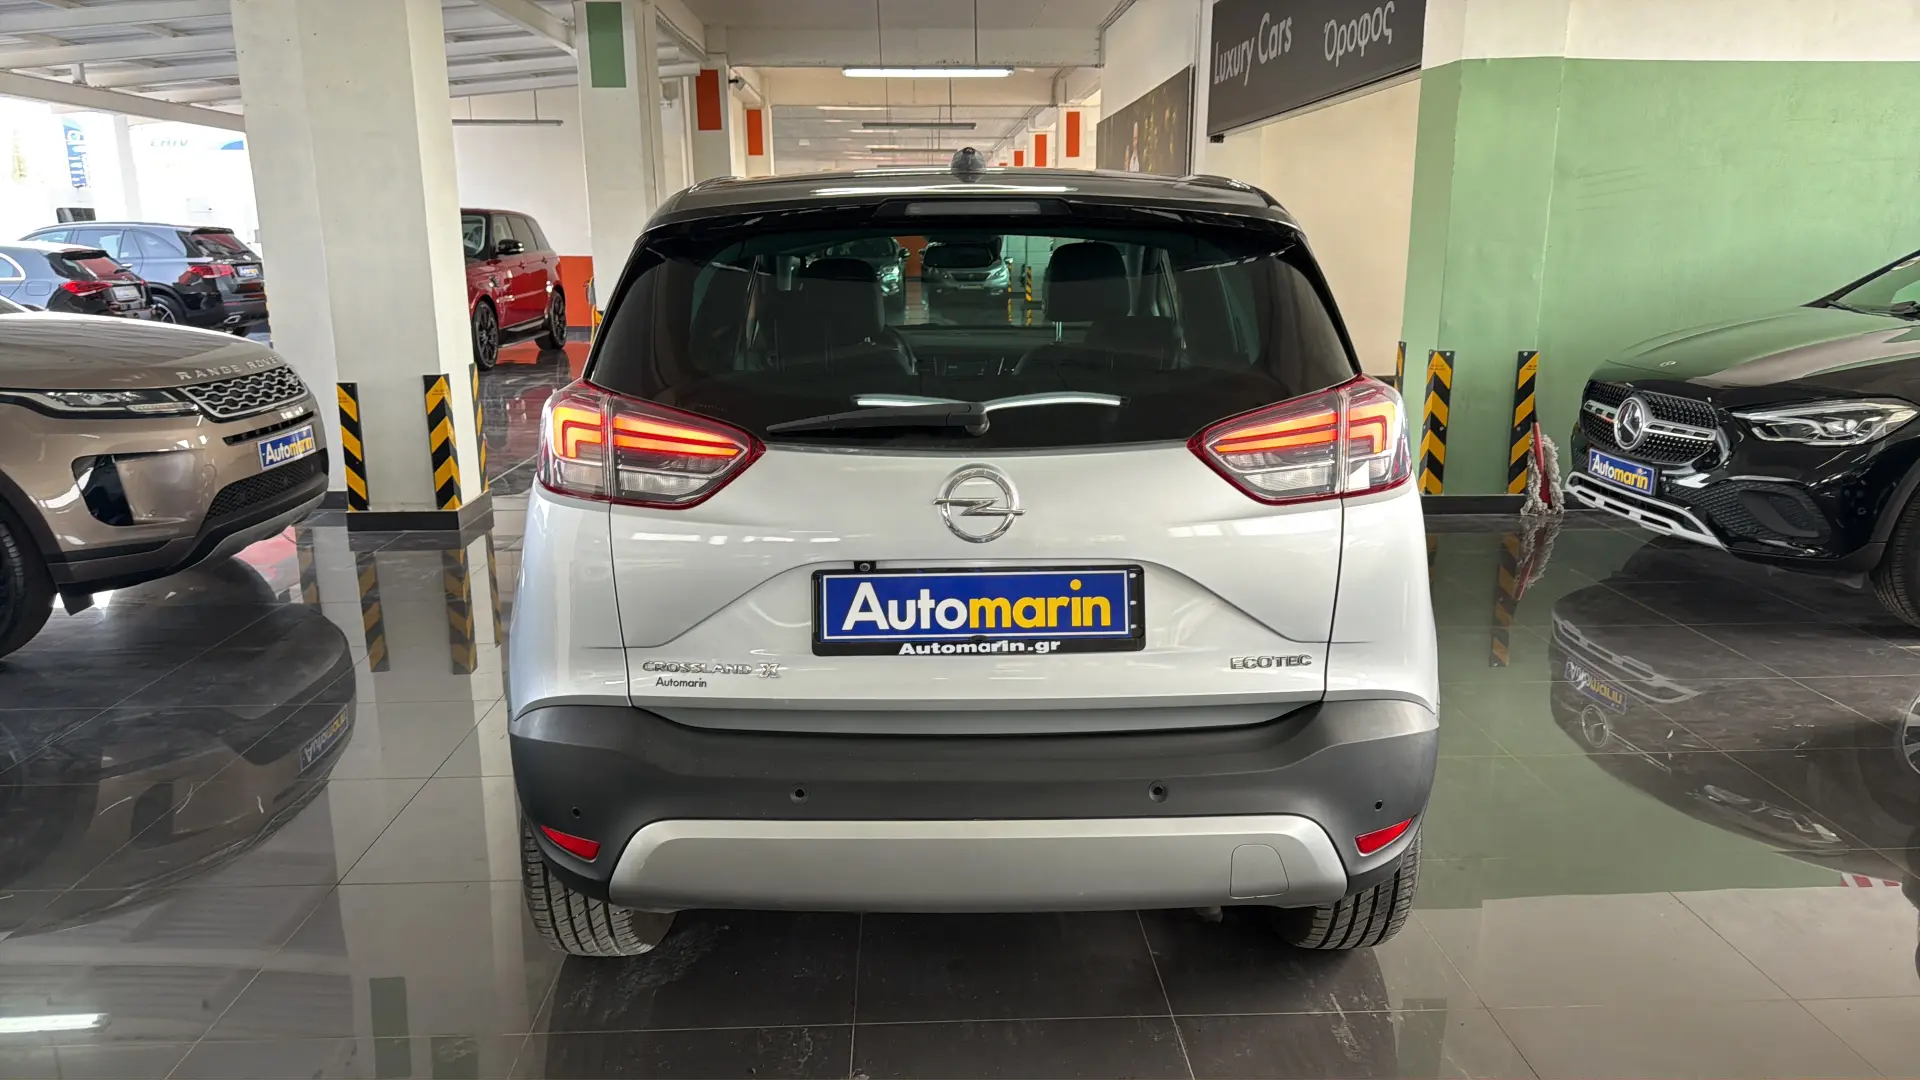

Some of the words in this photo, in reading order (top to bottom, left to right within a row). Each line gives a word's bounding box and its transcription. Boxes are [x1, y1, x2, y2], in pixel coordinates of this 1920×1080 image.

[1324, 0, 1395, 67] Όροφος
[1213, 37, 1255, 86] Luxury
[1258, 12, 1293, 64] Cars
[175, 364, 241, 380] RANGE
[264, 431, 313, 465] Automarin
[1592, 454, 1649, 490] Automarin
[841, 578, 1111, 631] Automarin
[898, 639, 1061, 655] Automarin.gr
[642, 661, 752, 675] CROSSLAND
[758, 663, 781, 679] X
[1229, 654, 1312, 670] ECOTEC
[655, 677, 707, 688] Automarin
